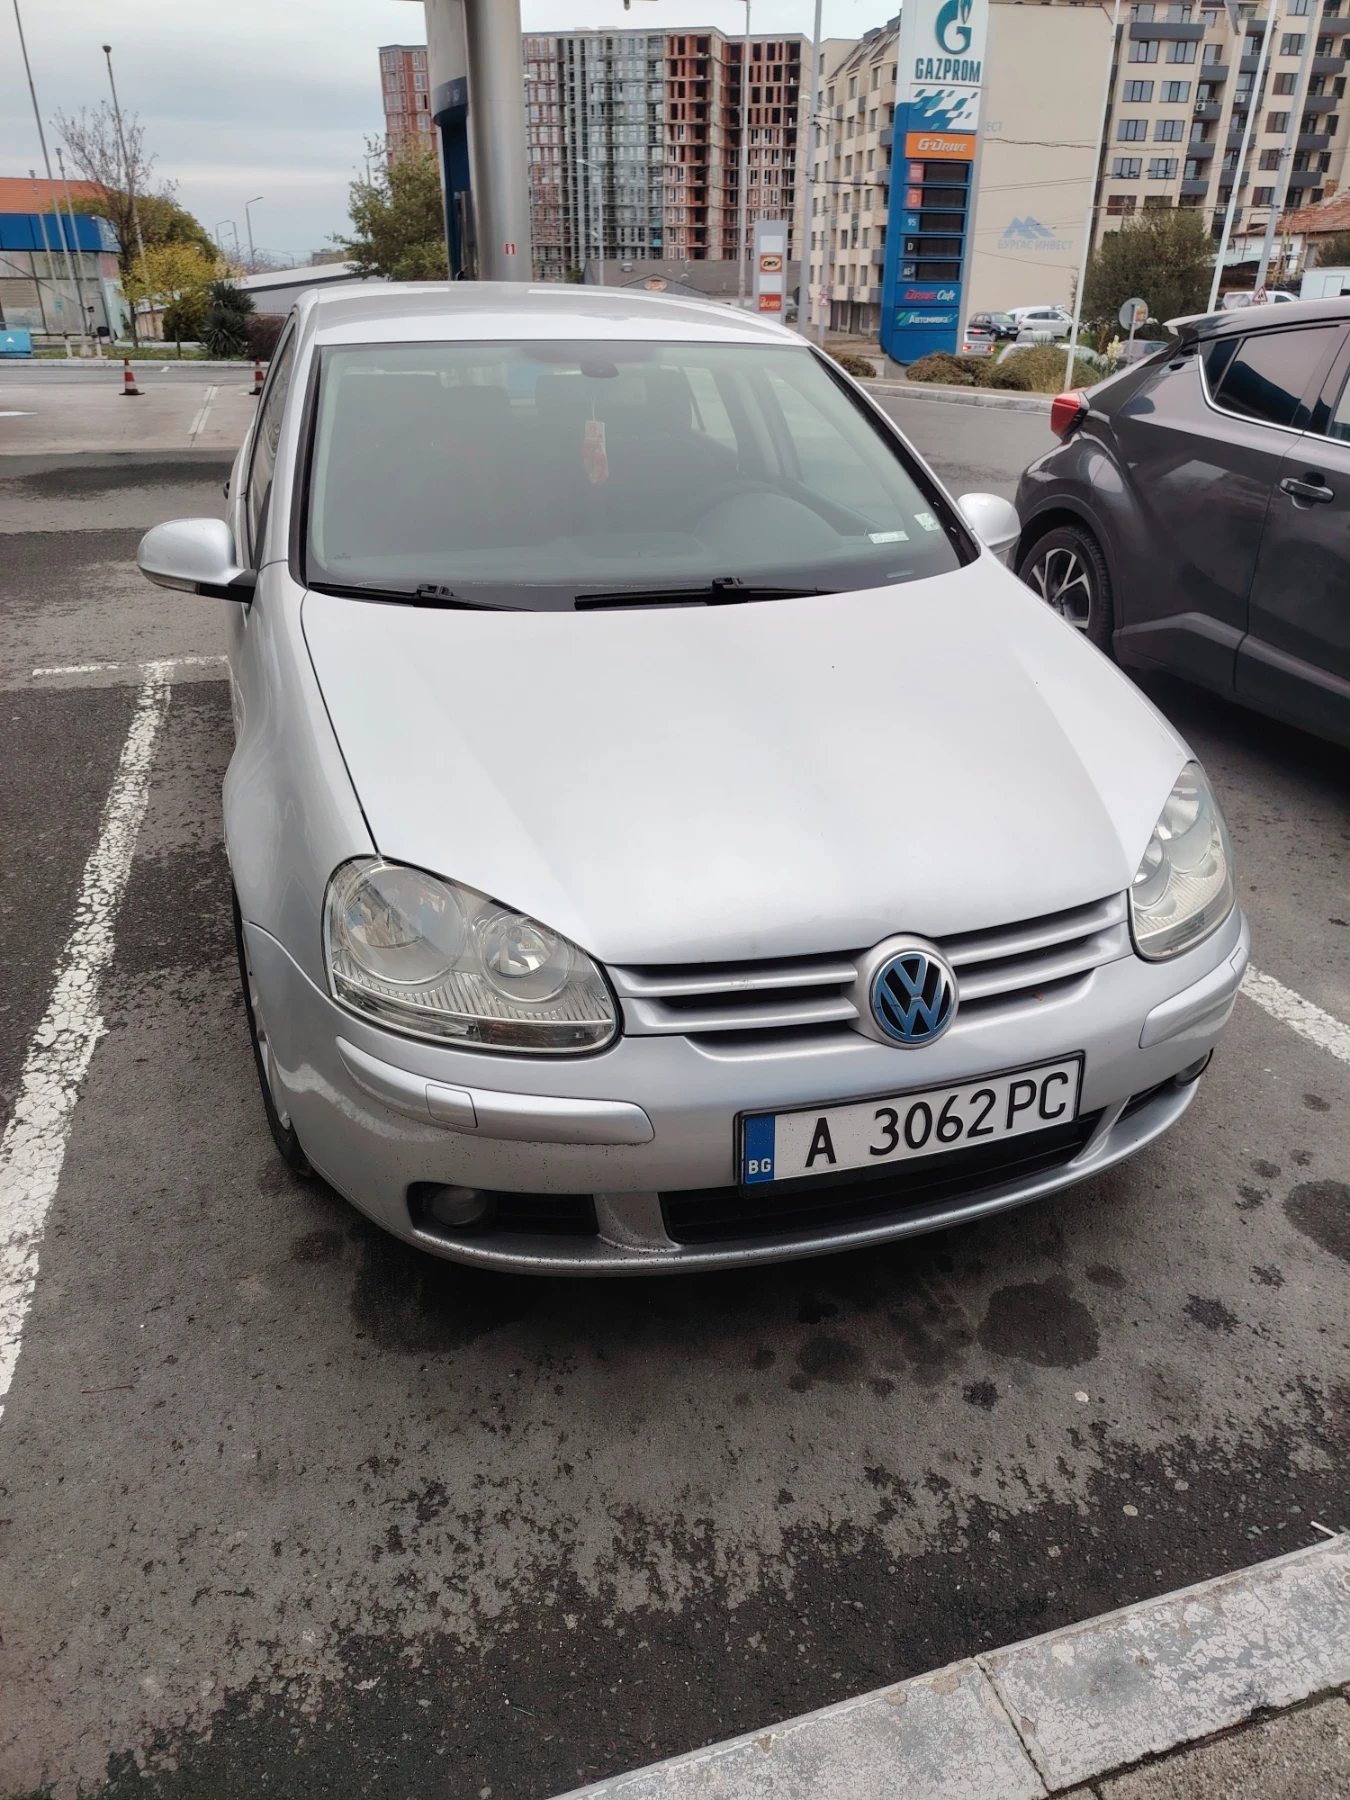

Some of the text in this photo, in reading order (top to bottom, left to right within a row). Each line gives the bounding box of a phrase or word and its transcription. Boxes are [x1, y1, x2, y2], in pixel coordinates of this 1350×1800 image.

[915, 58, 981, 83] GAZPROM
[907, 218, 917, 227] 95
[907, 242, 914, 251] D
[997, 239, 1073, 251] БУРГАС ИНВЕСТ
[748, 1157, 772, 1175] BG
[805, 1117, 837, 1168] A
[869, 1089, 997, 1156] 3062
